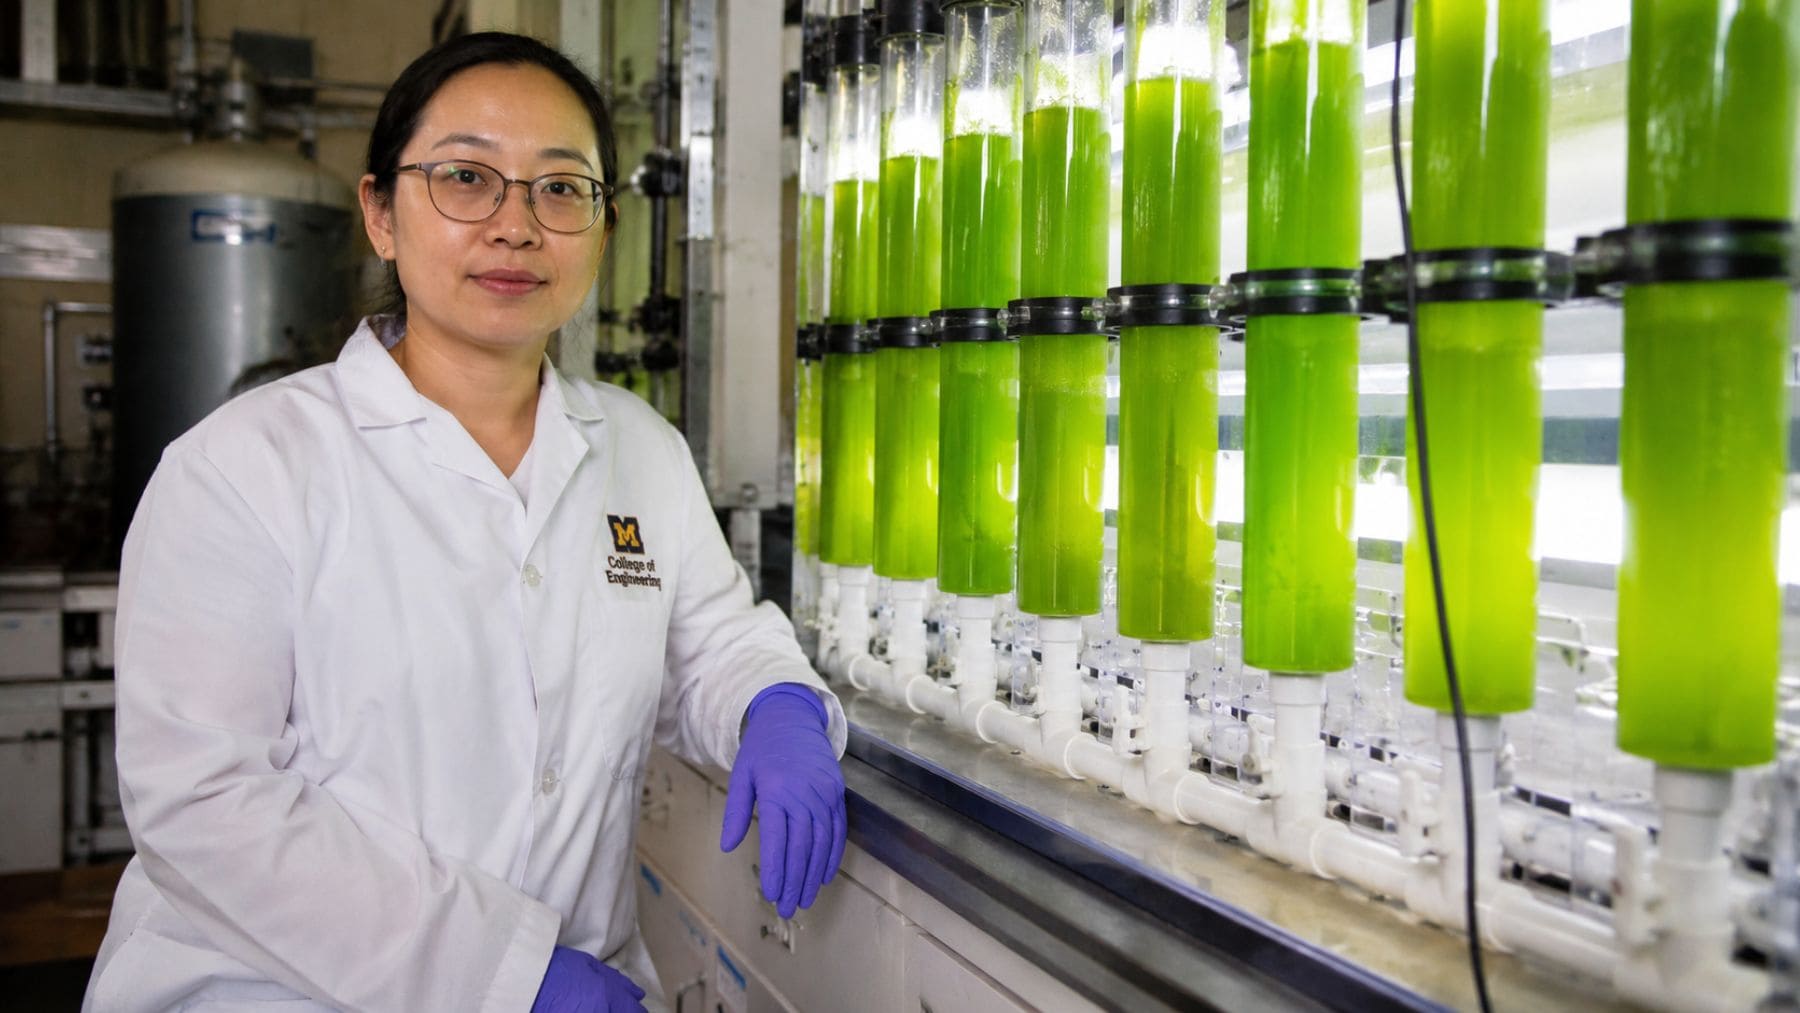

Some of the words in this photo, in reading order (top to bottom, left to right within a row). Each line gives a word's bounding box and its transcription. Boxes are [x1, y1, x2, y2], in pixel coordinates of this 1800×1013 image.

[610, 518, 643, 551] M
[608, 556, 645, 573] College
[647, 559, 655, 572] of
[606, 570, 661, 591] Engineering
